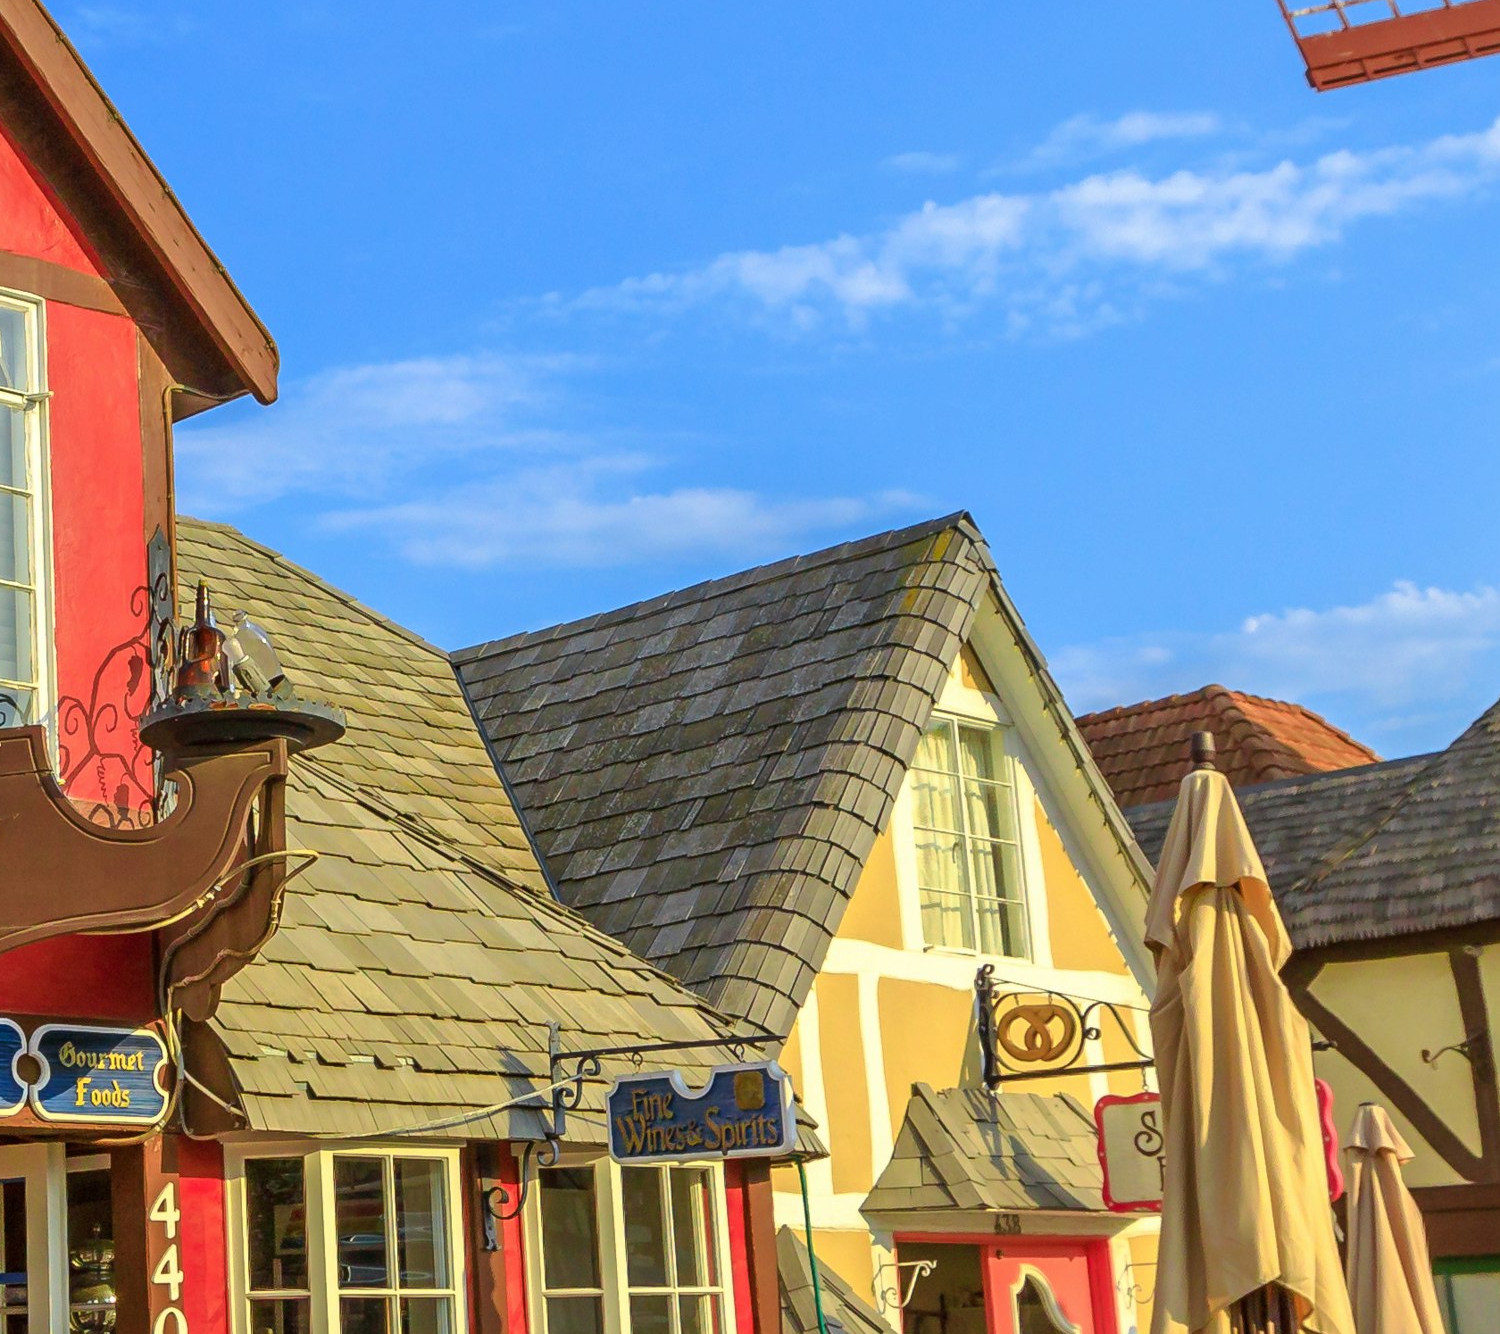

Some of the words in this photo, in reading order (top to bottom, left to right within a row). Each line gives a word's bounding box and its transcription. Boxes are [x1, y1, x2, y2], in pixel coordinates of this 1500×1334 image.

[58, 1040, 145, 1071] Gourmet
[75, 1077, 132, 1108] Foods
[631, 1088, 674, 1122] Fine
[615, 1114, 686, 1155] Wines
[703, 1105, 778, 1151] Spirits
[1134, 1110, 1164, 1157] S
